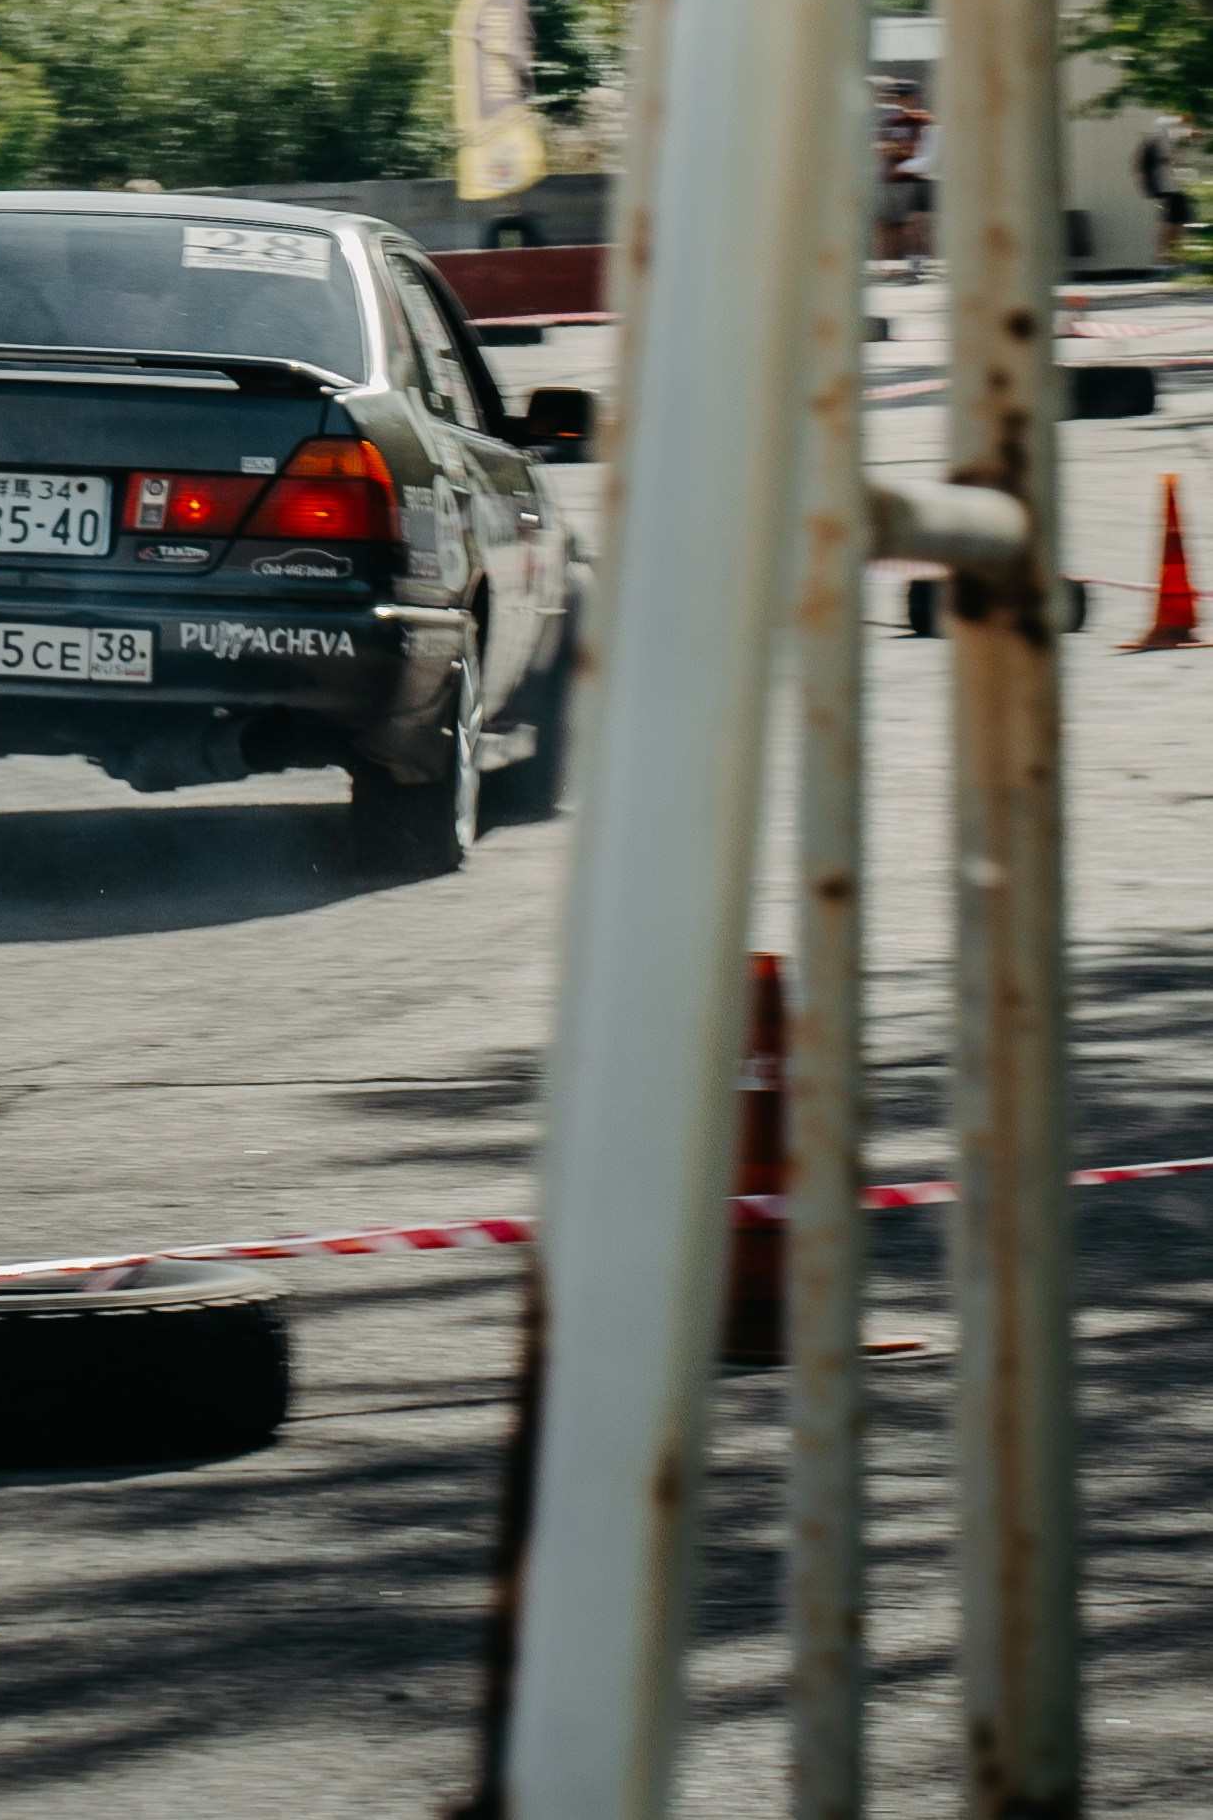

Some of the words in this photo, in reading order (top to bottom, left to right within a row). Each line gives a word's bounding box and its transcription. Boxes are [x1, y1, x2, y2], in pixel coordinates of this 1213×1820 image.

[206, 230, 306, 262] 28
[38, 480, 72, 501] 34
[95, 632, 136, 663] 38
